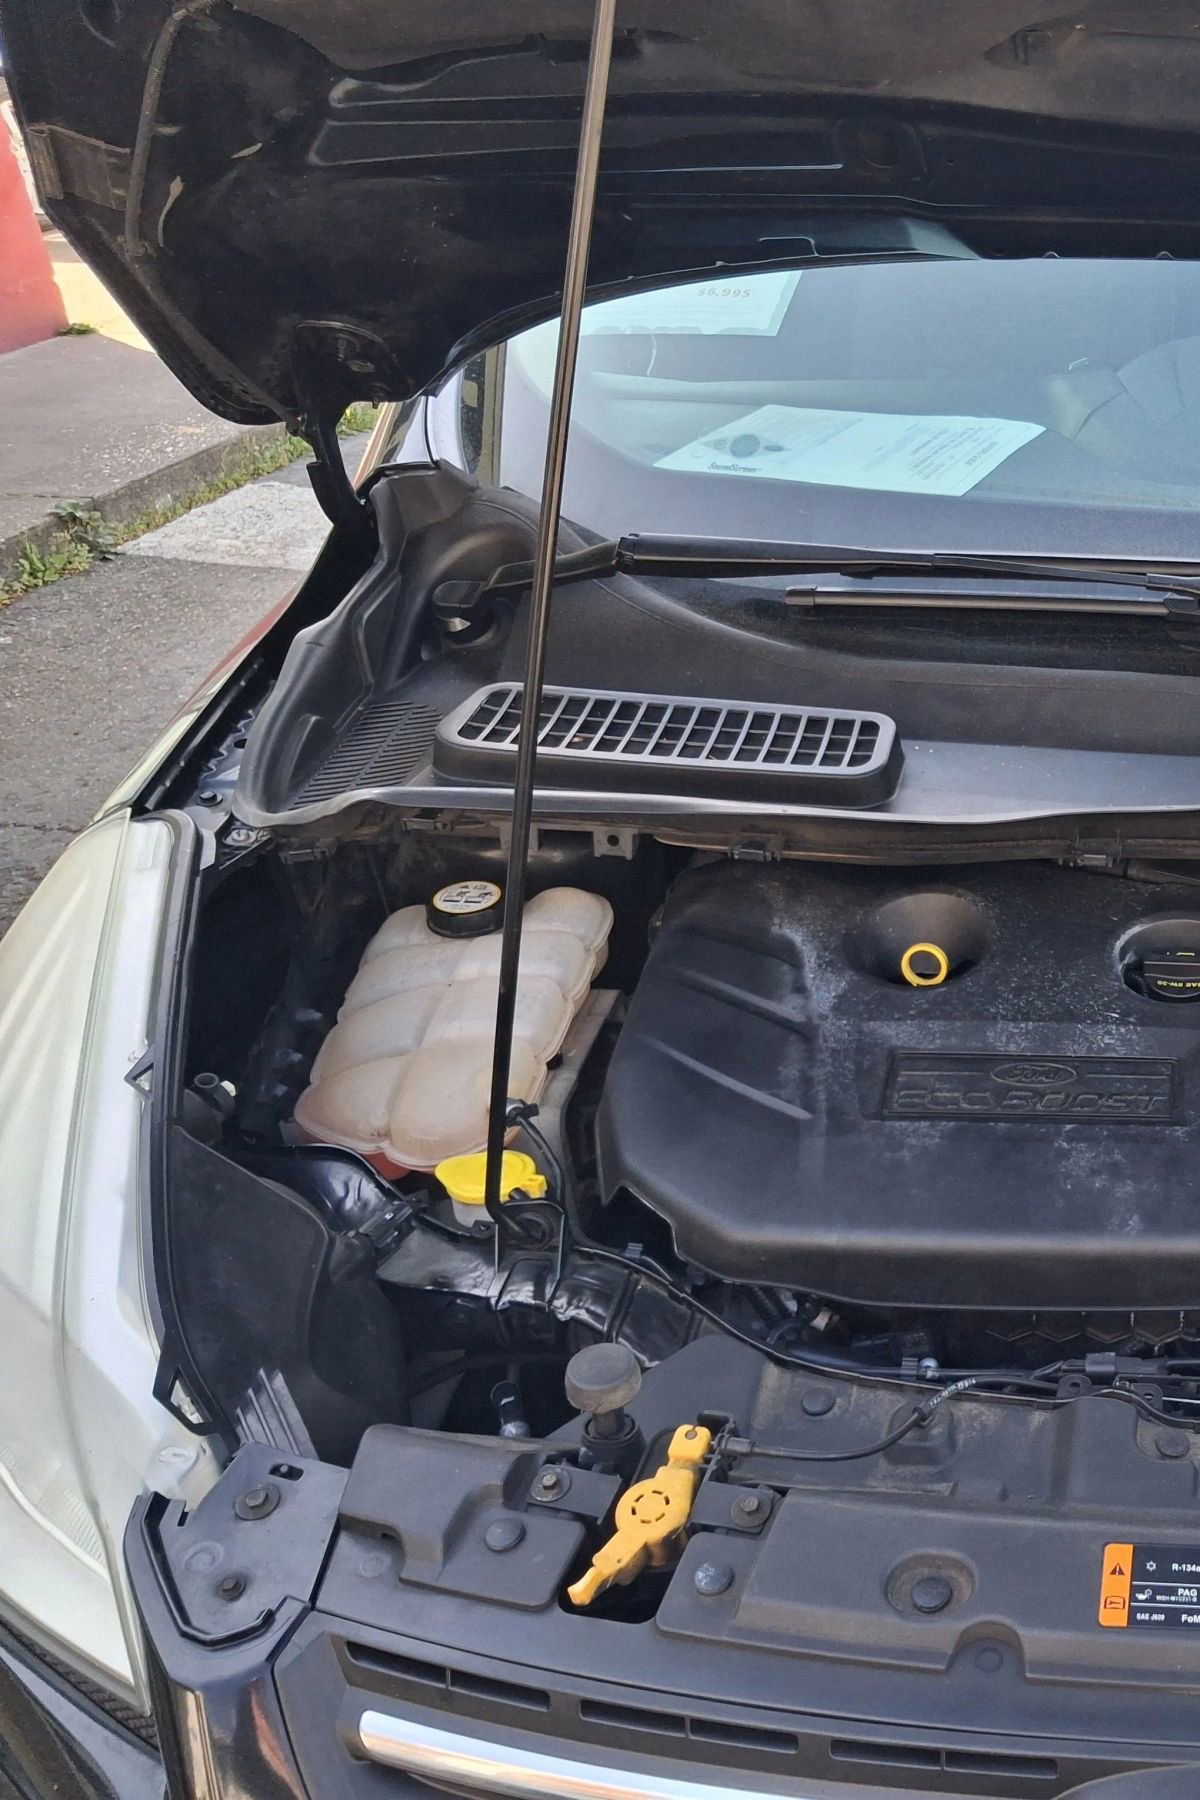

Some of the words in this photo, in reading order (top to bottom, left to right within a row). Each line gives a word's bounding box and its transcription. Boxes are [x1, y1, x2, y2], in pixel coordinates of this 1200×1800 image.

[1005, 1063, 1062, 1083] Ford
[1172, 1563, 1200, 1572] R-134a
[1178, 1588, 1197, 1597] PAG
